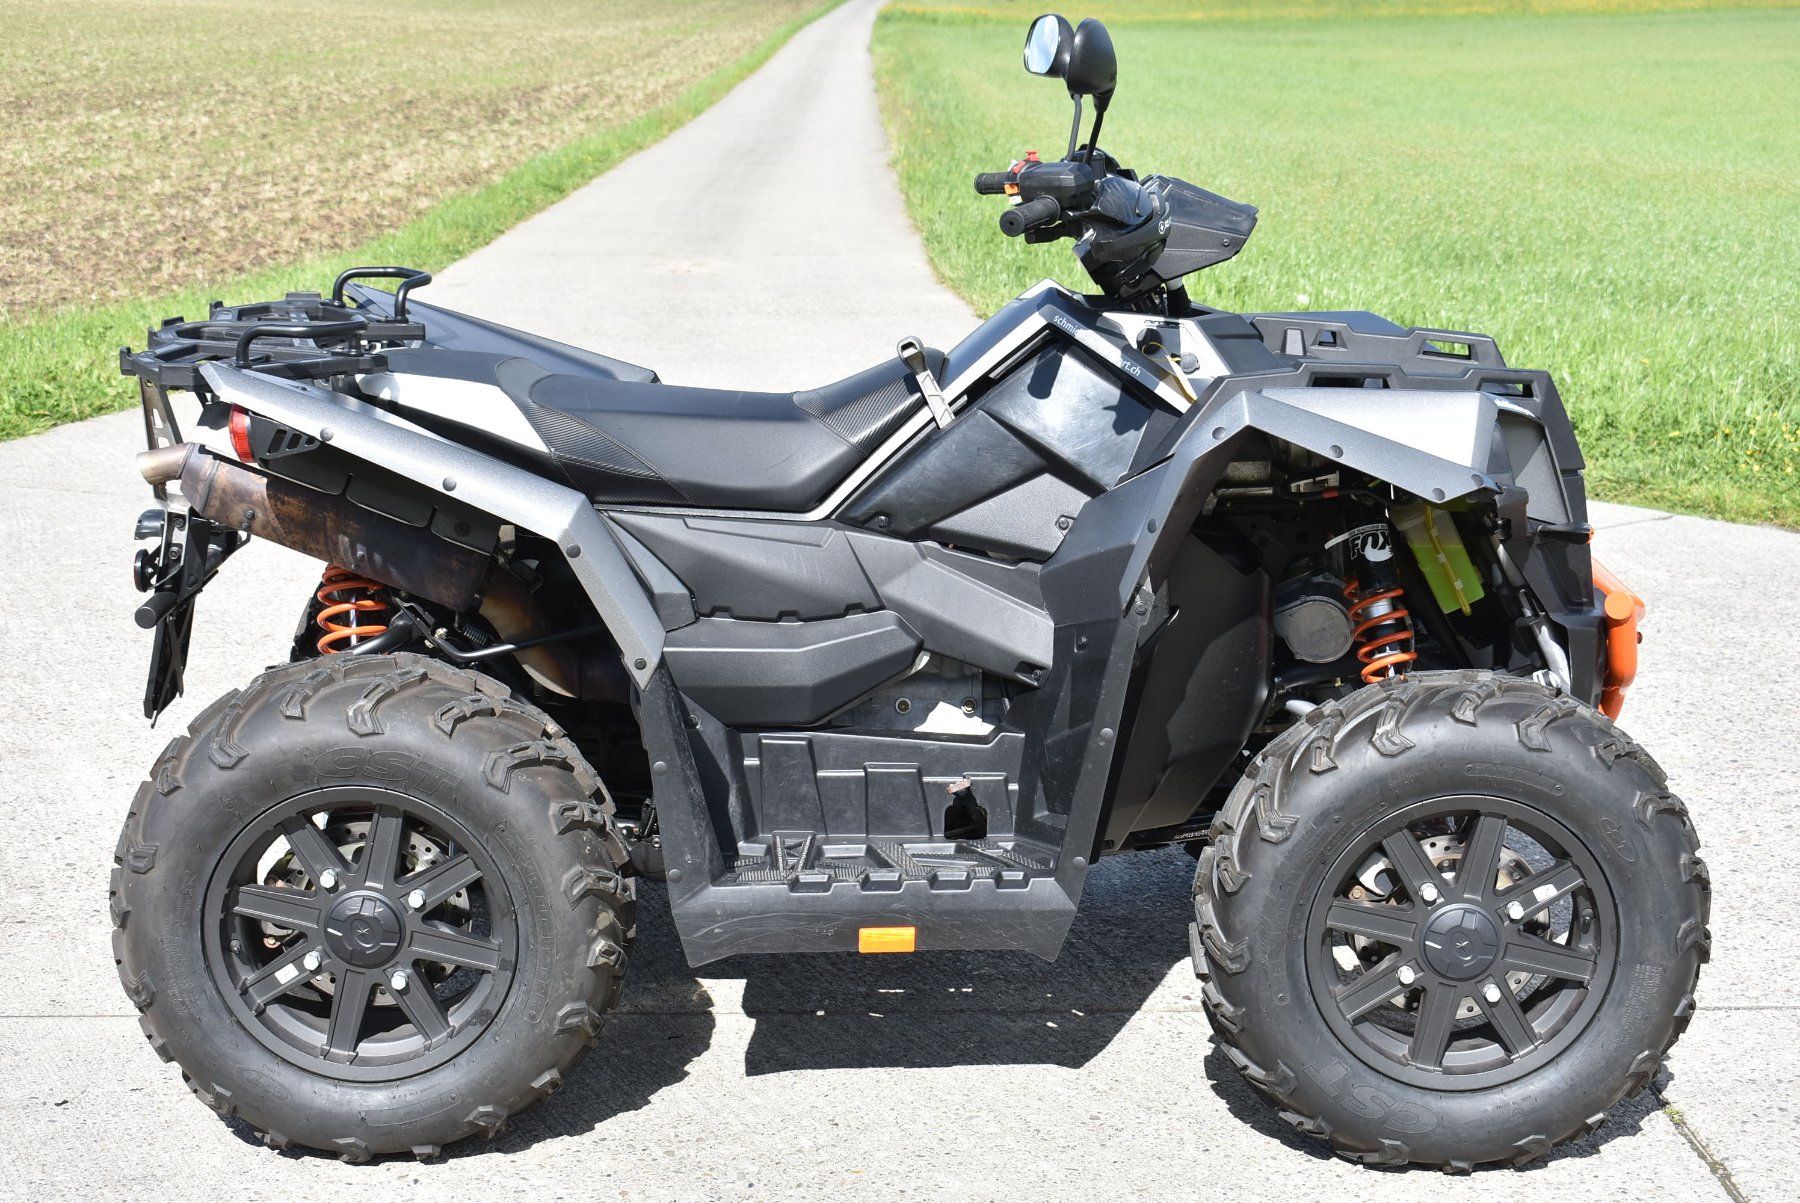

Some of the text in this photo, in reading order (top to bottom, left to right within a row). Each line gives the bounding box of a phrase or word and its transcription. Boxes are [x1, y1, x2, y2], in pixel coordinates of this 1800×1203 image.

[1348, 529, 1393, 561] FOX
[313, 747, 464, 796] CST
[1303, 1060, 1440, 1133] CST
